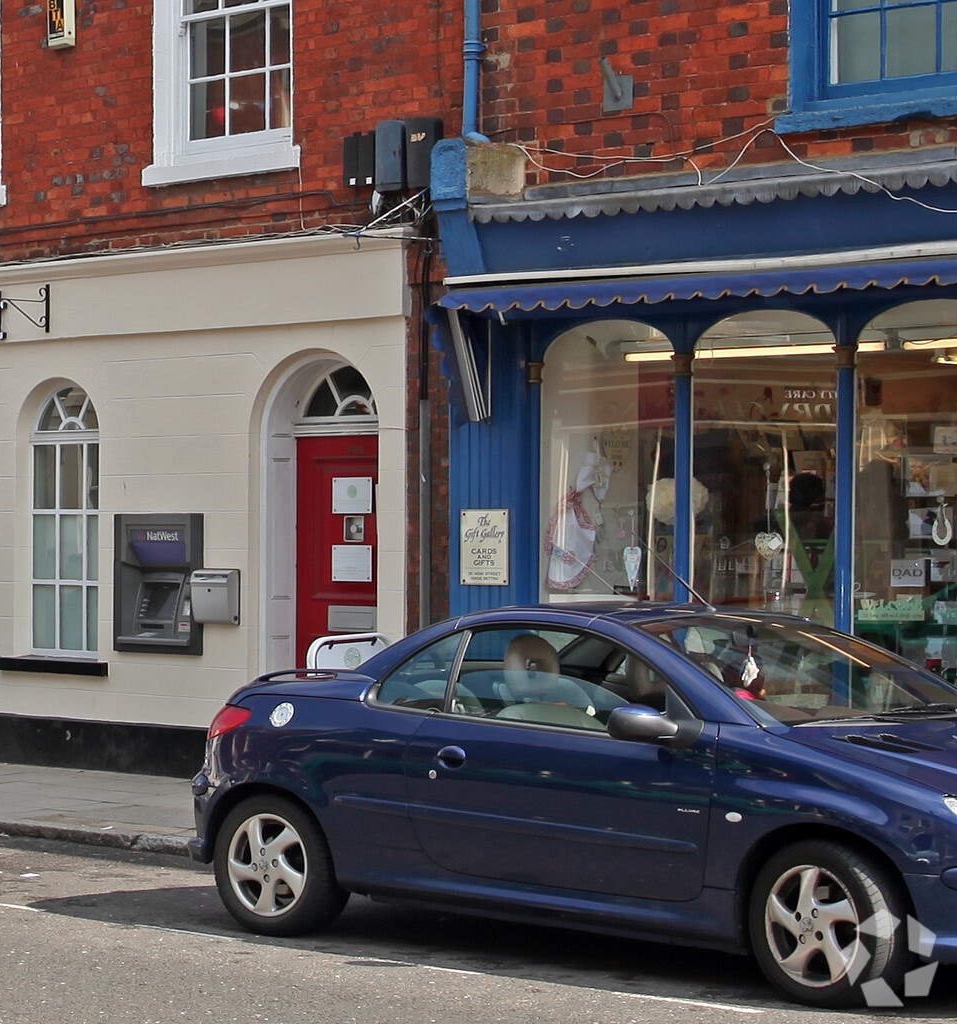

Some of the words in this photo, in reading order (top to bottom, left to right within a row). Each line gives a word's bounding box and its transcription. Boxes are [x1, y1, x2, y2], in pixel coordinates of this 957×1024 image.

[477, 513, 491, 527] The
[146, 531, 179, 541] NatWest
[464, 527, 480, 543] Gift
[479, 525, 505, 543] Gallery
[892, 568, 923, 577] DAD
